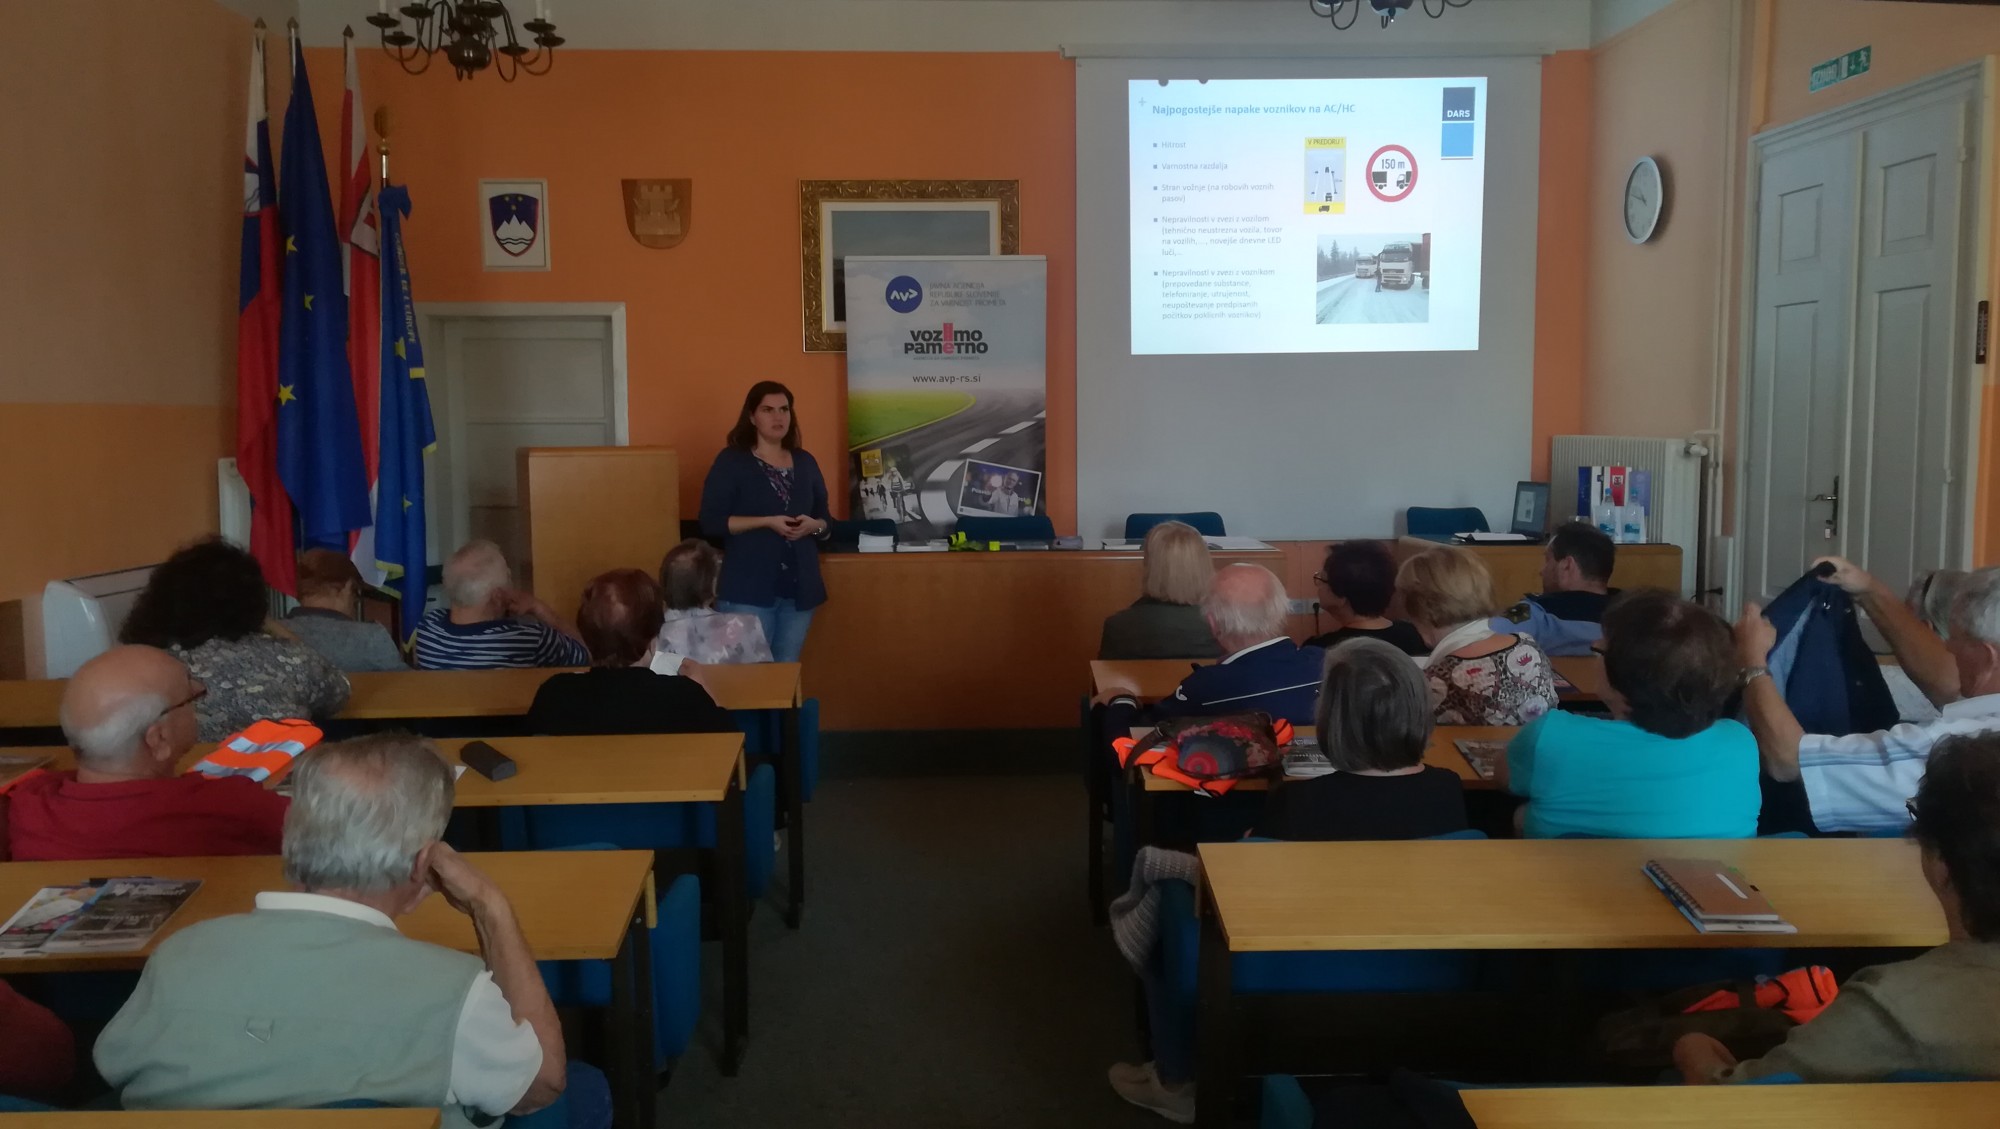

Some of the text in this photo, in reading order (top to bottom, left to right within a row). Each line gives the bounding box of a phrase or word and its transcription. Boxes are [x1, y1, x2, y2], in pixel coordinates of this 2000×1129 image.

[1152, 103, 1356, 116] Najpogostejše napake voznikov na AC/HC
[1447, 110, 1470, 118] DARS
[1161, 141, 1186, 149] Hitrost
[1162, 162, 1228, 171] Varnostna razdalja
[1381, 159, 1405, 170] 150 m
[1161, 184, 1181, 192] Stran
[1183, 183, 1206, 193] vožnje
[1222, 183, 1249, 191] robovih
[1251, 183, 1274, 191] voznih
[1162, 194, 1186, 204] pasov)
[1162, 215, 1210, 225] Nepravilnosti
[1217, 215, 1235, 223] zvezi
[1239, 236, 1266, 244] dnevne
[1162, 269, 1210, 278] Nepravilnosti
[1242, 268, 1275, 276] voznikom
[1216, 301, 1258, 310] predpisanih
[1194, 312, 1226, 320] poklicnih
[913, 374, 981, 385] www.avp-rs.si
